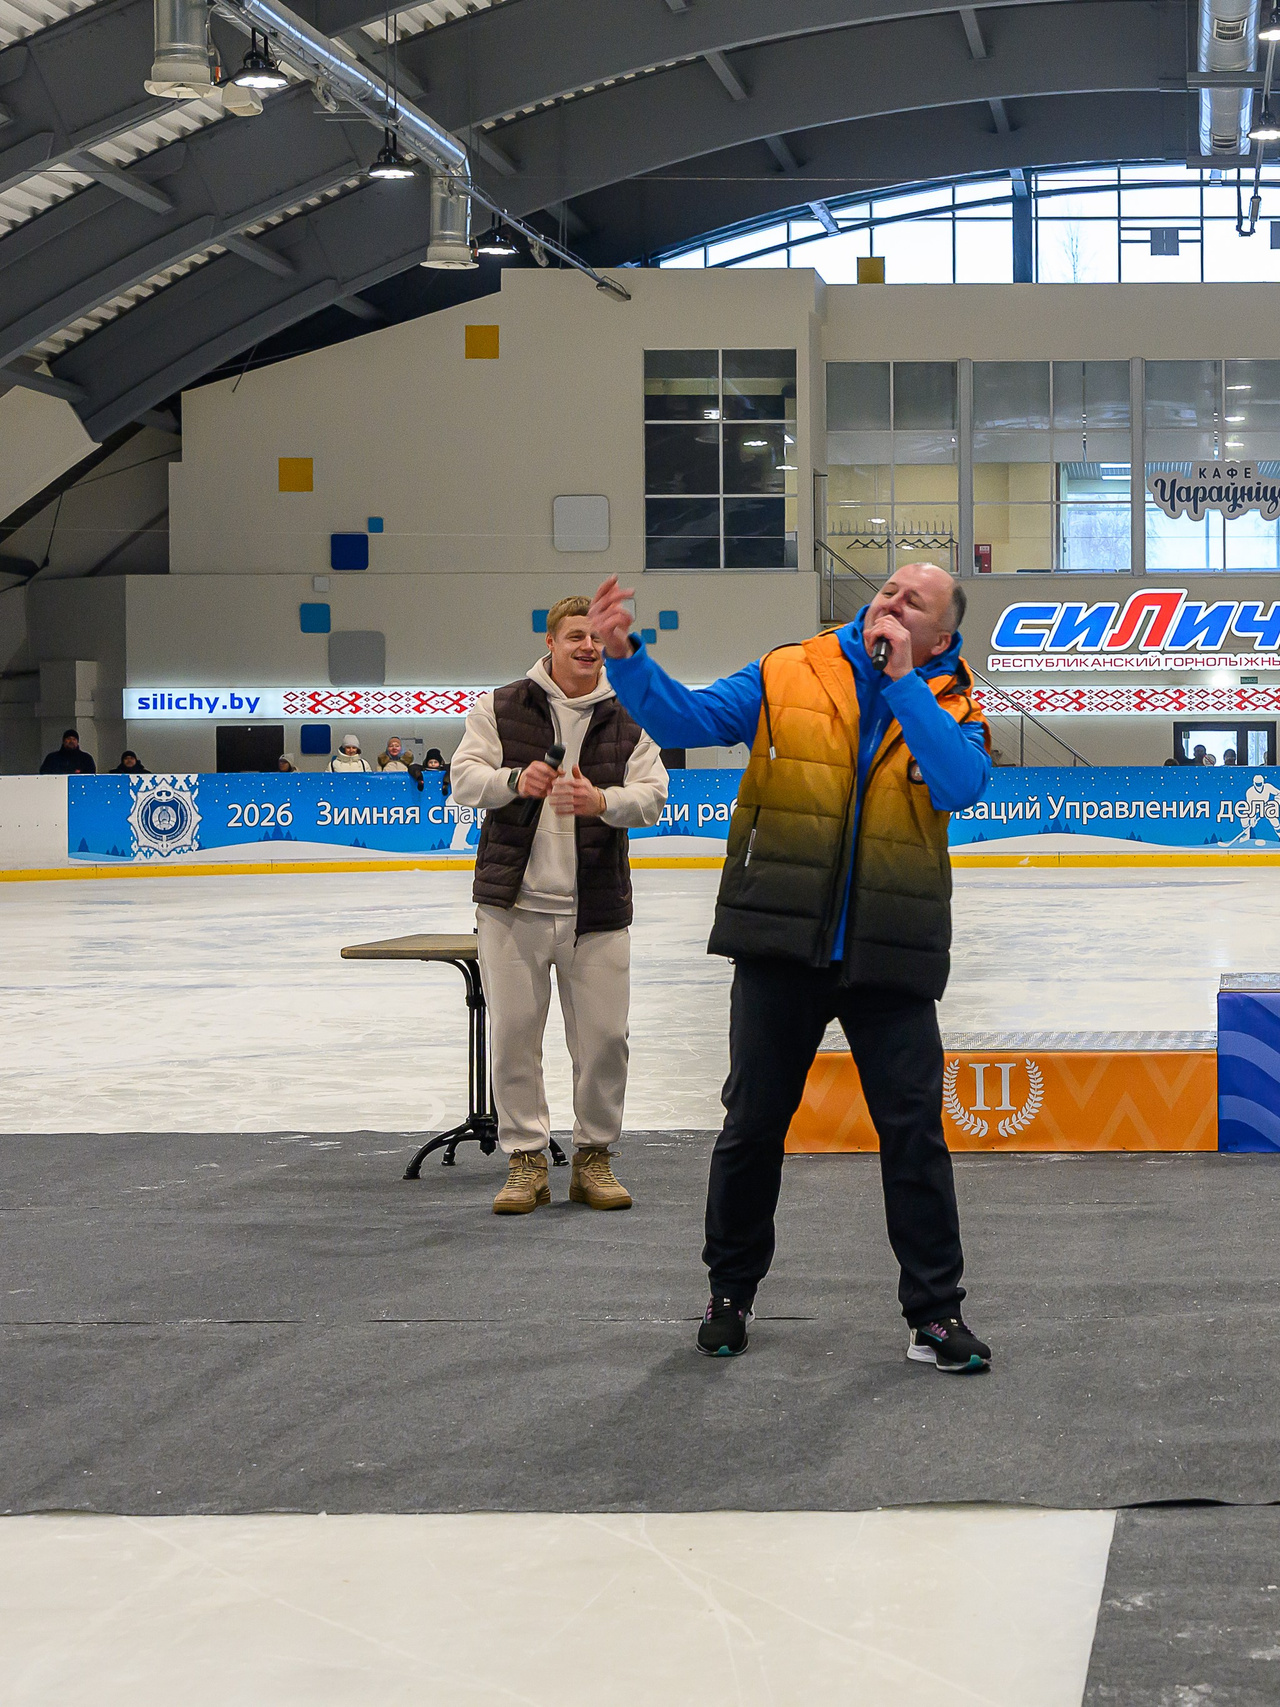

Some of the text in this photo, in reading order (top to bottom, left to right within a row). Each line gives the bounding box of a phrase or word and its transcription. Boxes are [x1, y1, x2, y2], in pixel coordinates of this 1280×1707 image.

[1198, 467, 1252, 479] КАФЕ
[991, 655, 1161, 668] РЕСПУБЛИКАНСКИЙ
[138, 692, 260, 714] silichy.by
[227, 802, 293, 827] 2026
[316, 802, 420, 825] Зимняя
[1047, 796, 1210, 825] Управления
[968, 1063, 1017, 1111] II
